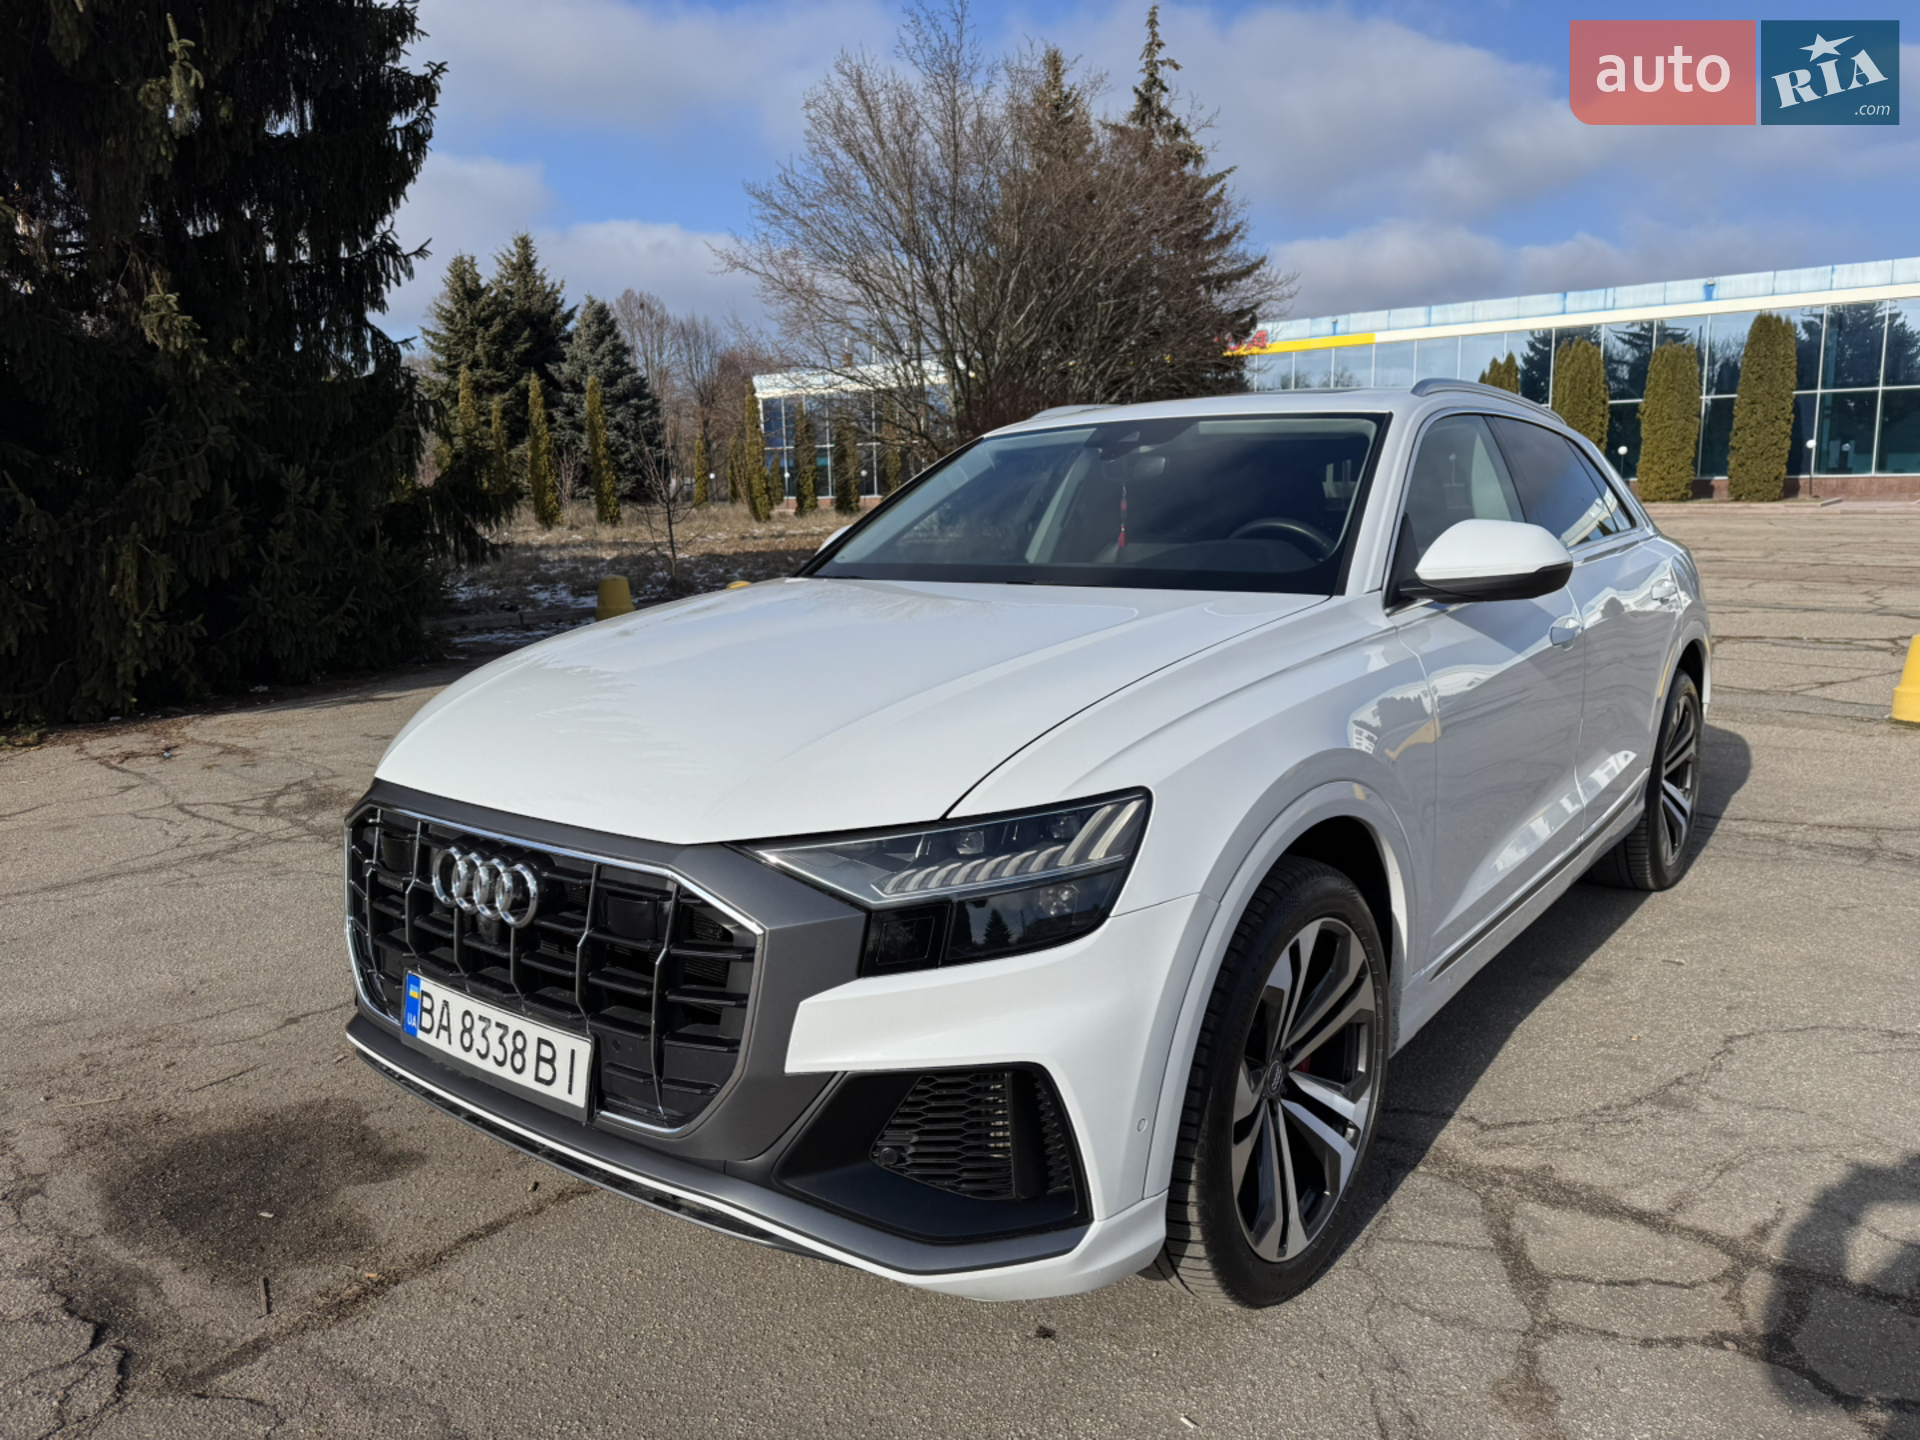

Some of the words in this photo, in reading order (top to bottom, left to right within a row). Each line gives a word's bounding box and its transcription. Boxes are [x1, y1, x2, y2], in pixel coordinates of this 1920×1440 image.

[407, 1011, 417, 1028] UA
[419, 989, 452, 1045] BA
[460, 1009, 527, 1075] 8338
[534, 1036, 576, 1095] BI
